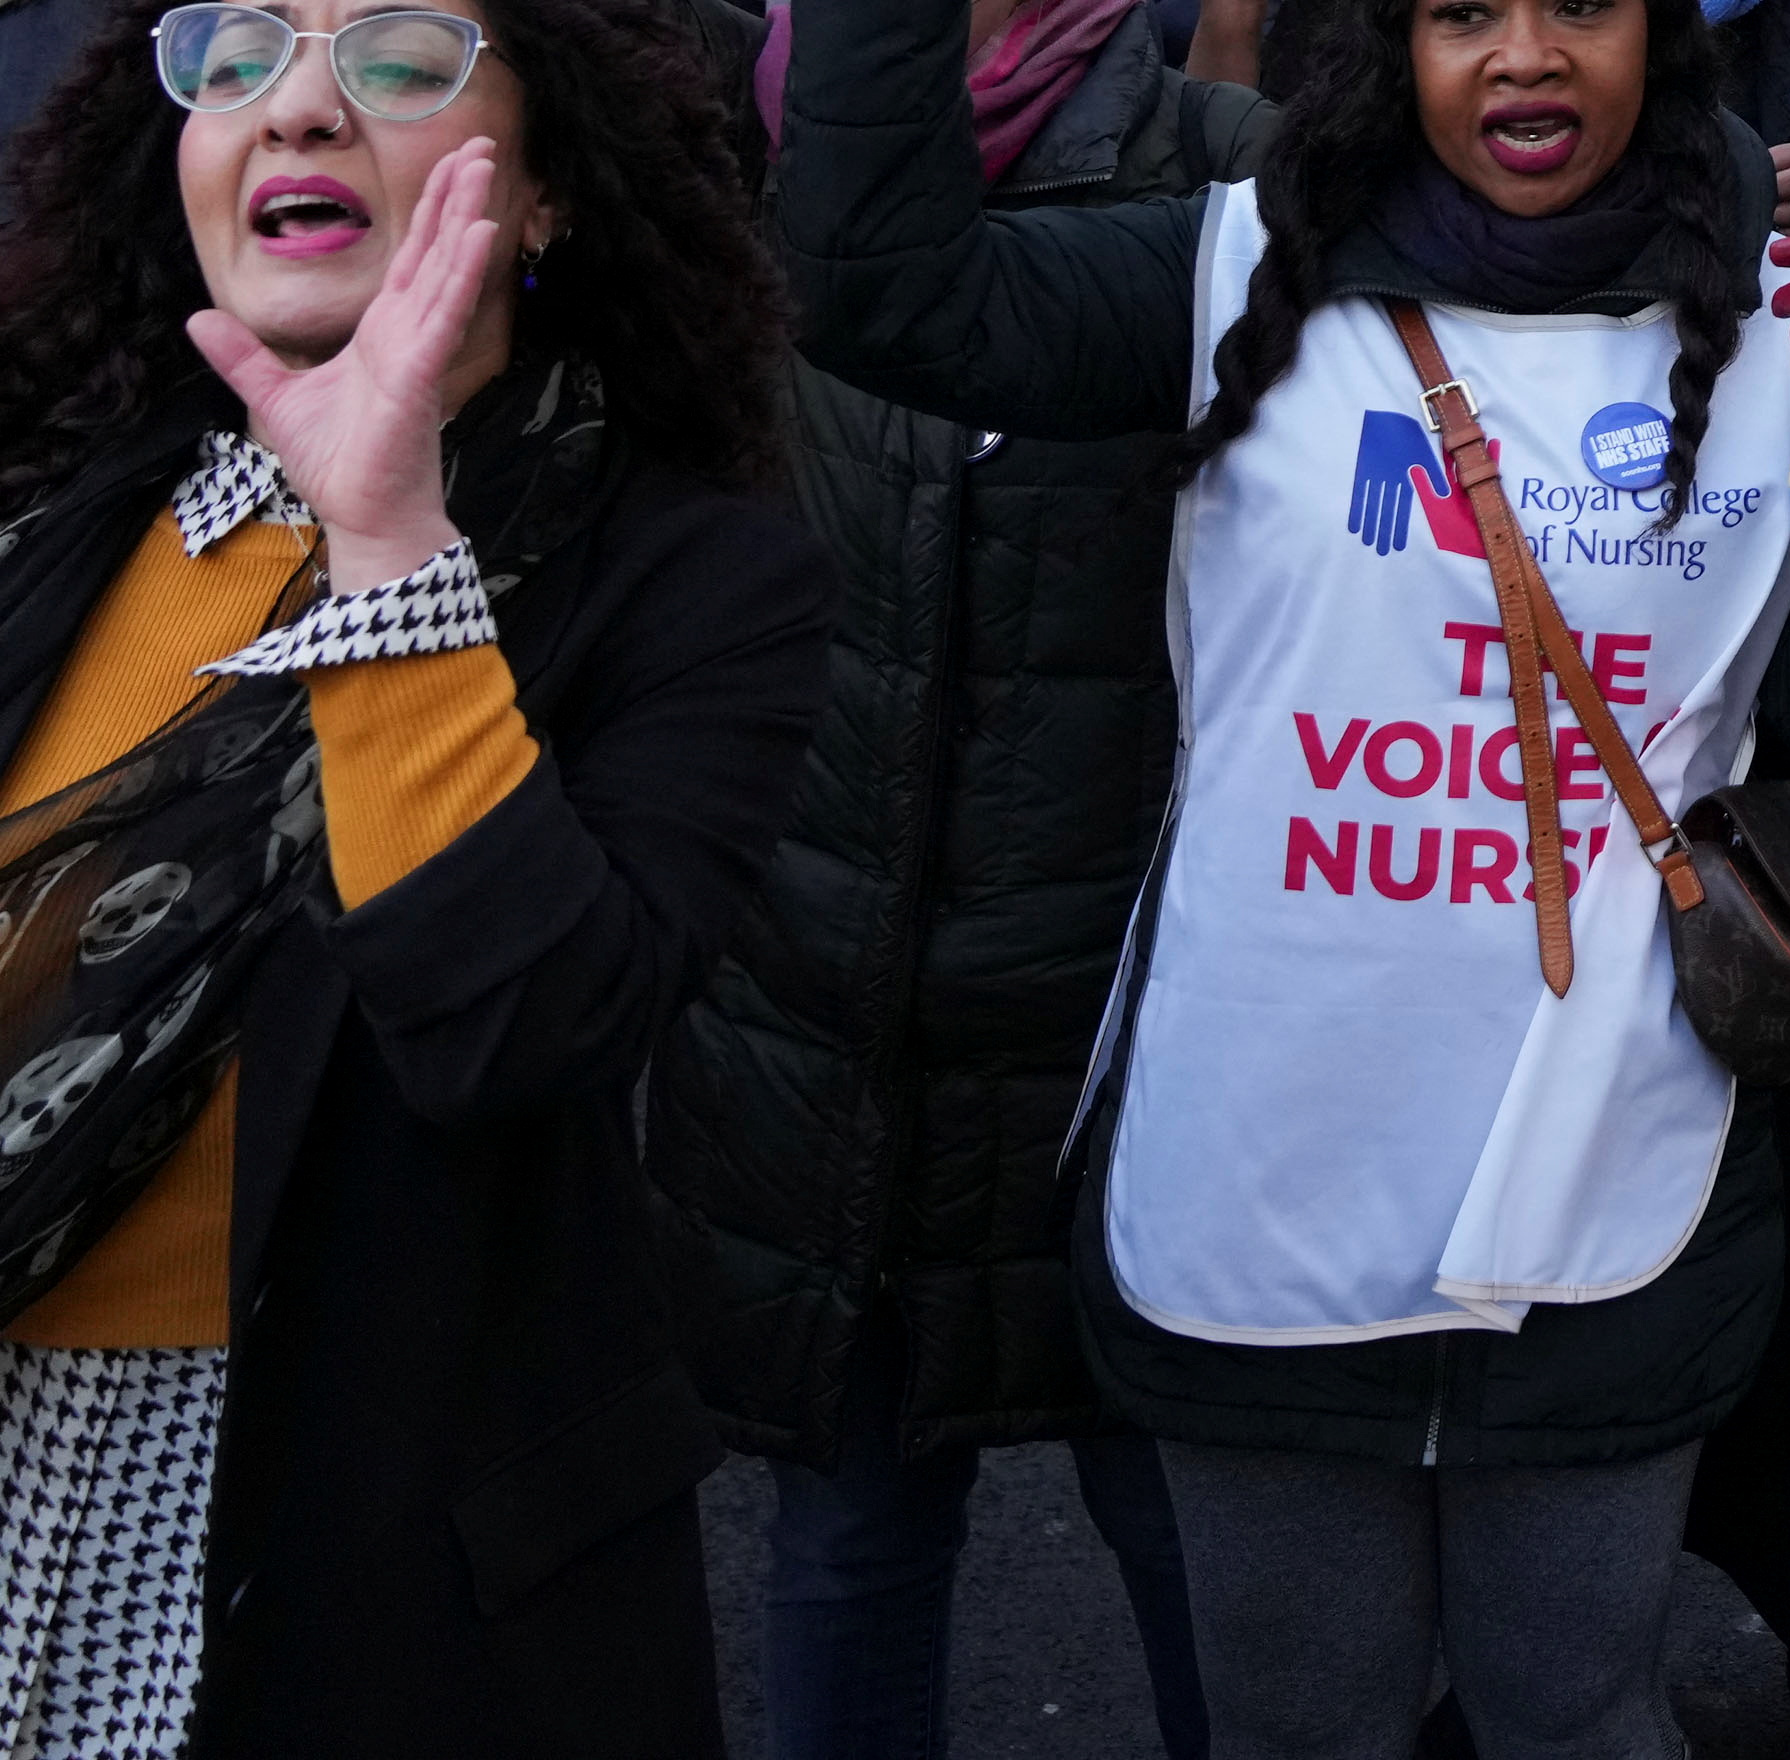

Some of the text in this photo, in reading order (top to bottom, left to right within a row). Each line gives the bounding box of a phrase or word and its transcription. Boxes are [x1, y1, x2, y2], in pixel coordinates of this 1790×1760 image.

[1595, 436, 1670, 469] NHS STAFF
[1598, 420, 1667, 450] STAND WITH
[1520, 478, 1619, 525] Royal
[1566, 529, 1708, 581] Nursing
